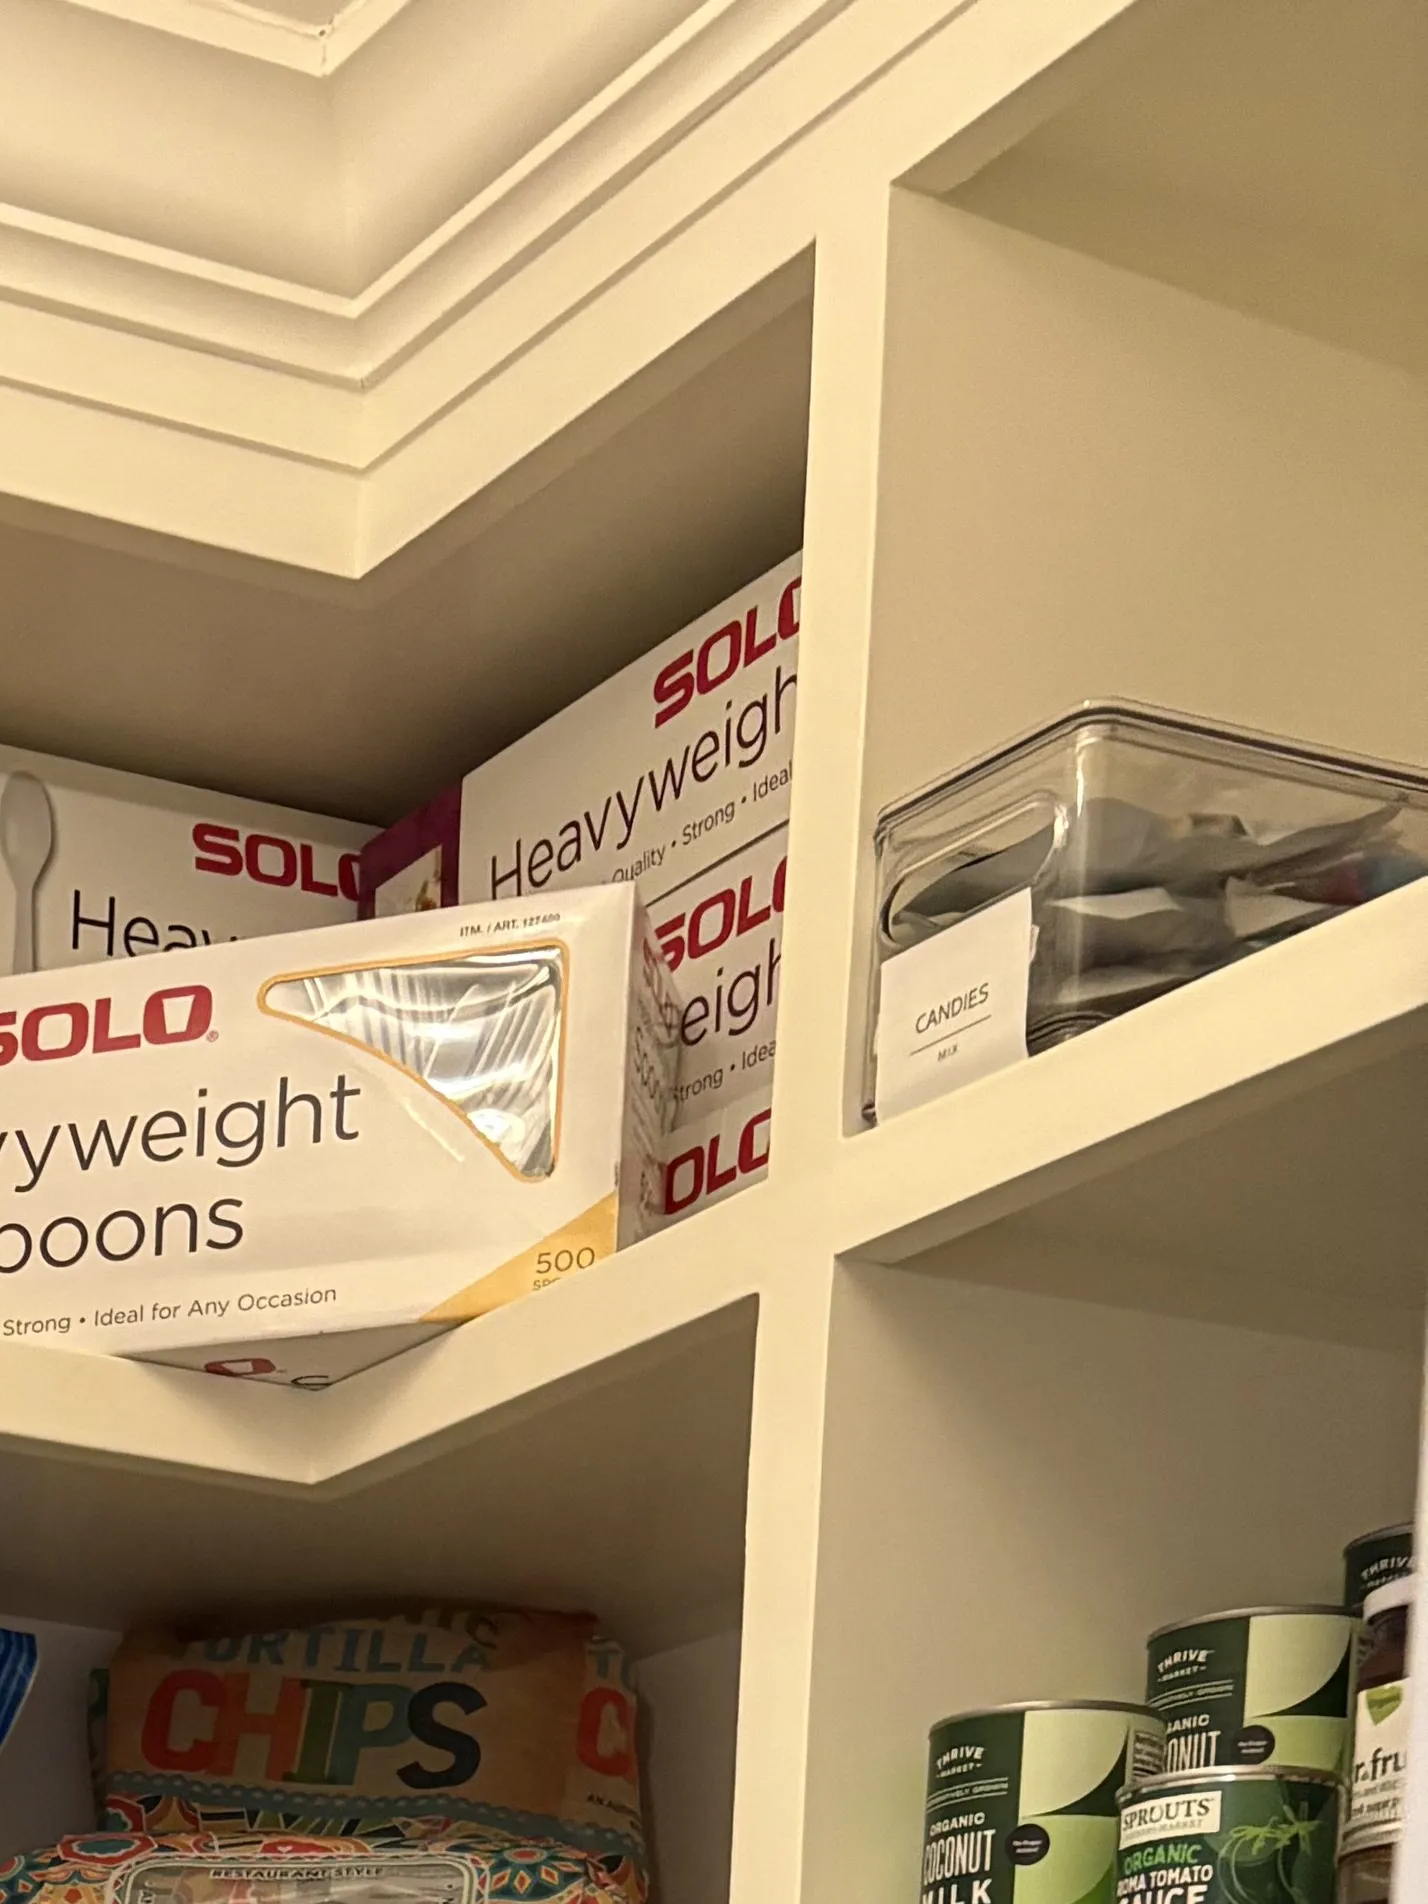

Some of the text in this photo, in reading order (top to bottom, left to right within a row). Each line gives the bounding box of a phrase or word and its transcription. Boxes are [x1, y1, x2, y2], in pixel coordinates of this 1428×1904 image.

[682, 801, 737, 847] Strong
[752, 765, 793, 802] Ideal
[915, 982, 989, 1034] CANDIES
[535, 1246, 595, 1275] 500
[2, 1287, 337, 1337] Strong Ideal for Any Occasion
[1158, 1649, 1210, 1672] THRIVE
[141, 1667, 489, 1791] CHIPS
[936, 1746, 985, 1770] THRIVE
[930, 1812, 985, 1835] ORGANIC
[1123, 1797, 1211, 1832] SPROUTS
[924, 1829, 996, 1886] COCONUT
[1124, 1843, 1202, 1875] ORGANIC
[209, 1866, 384, 1883] RESTAURANT STYLE
[1149, 1864, 1213, 1892] TOMATO
